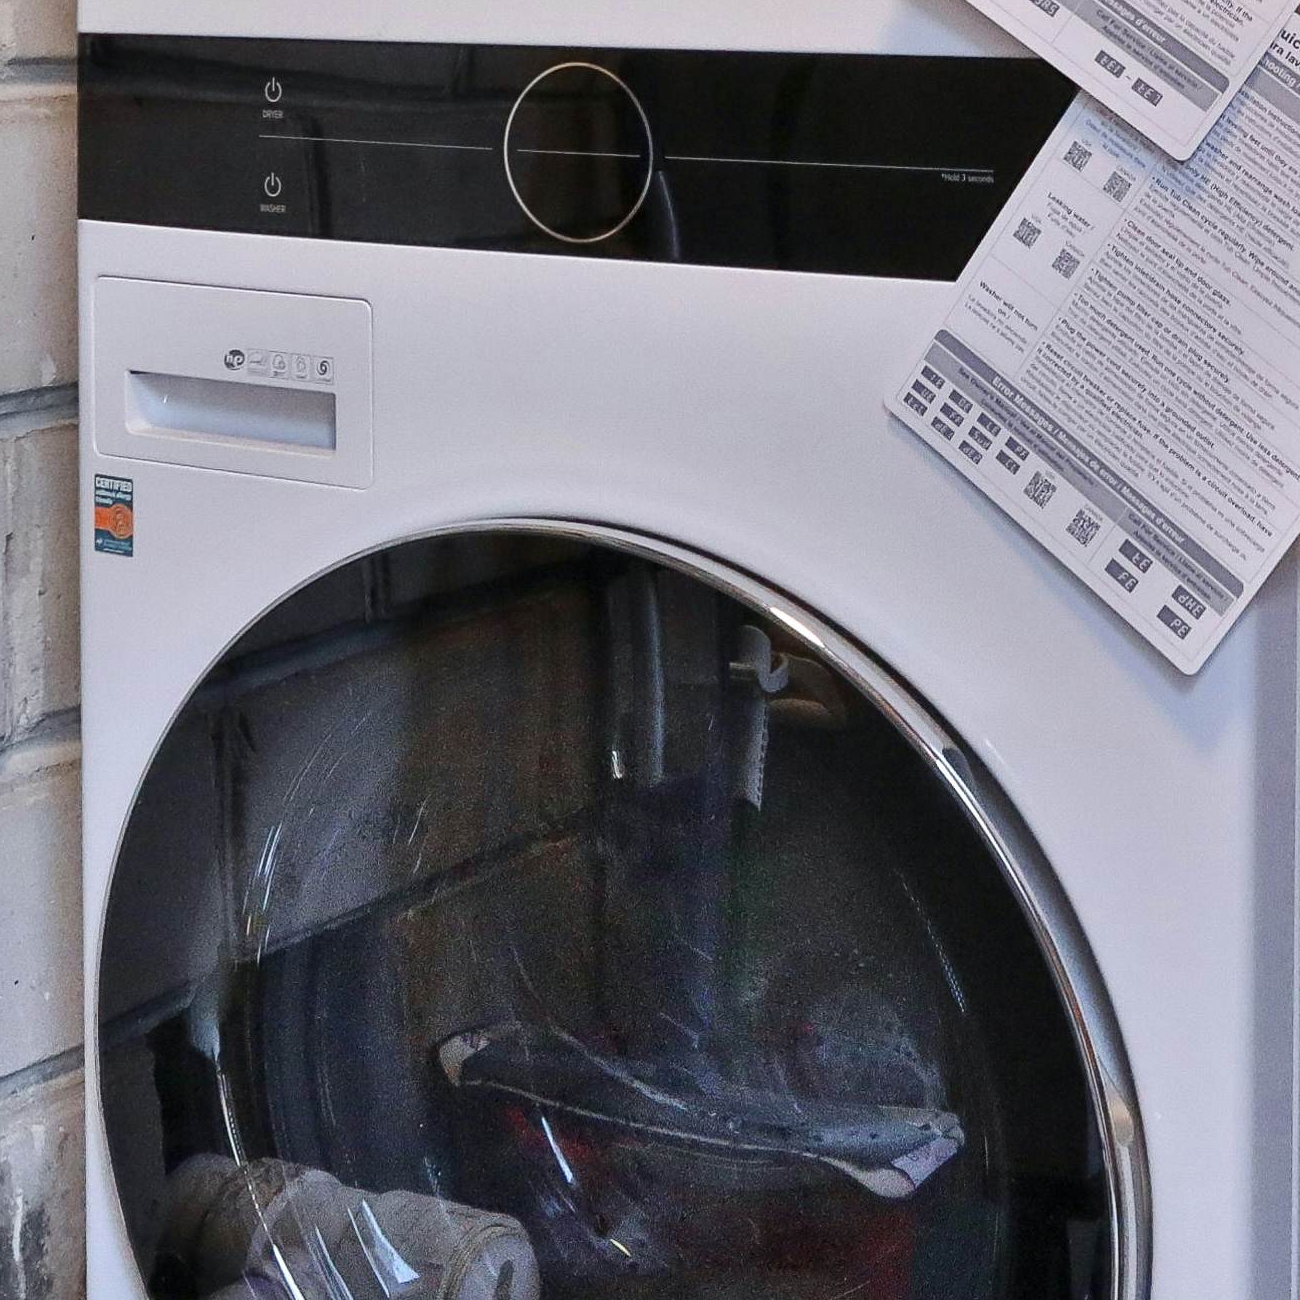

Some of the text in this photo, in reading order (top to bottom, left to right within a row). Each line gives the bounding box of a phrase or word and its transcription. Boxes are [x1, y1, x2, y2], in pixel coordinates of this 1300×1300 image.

[1266, 39, 1284, 56] ra
[262, 109, 284, 119] DRYER
[260, 203, 286, 213] WASHER
